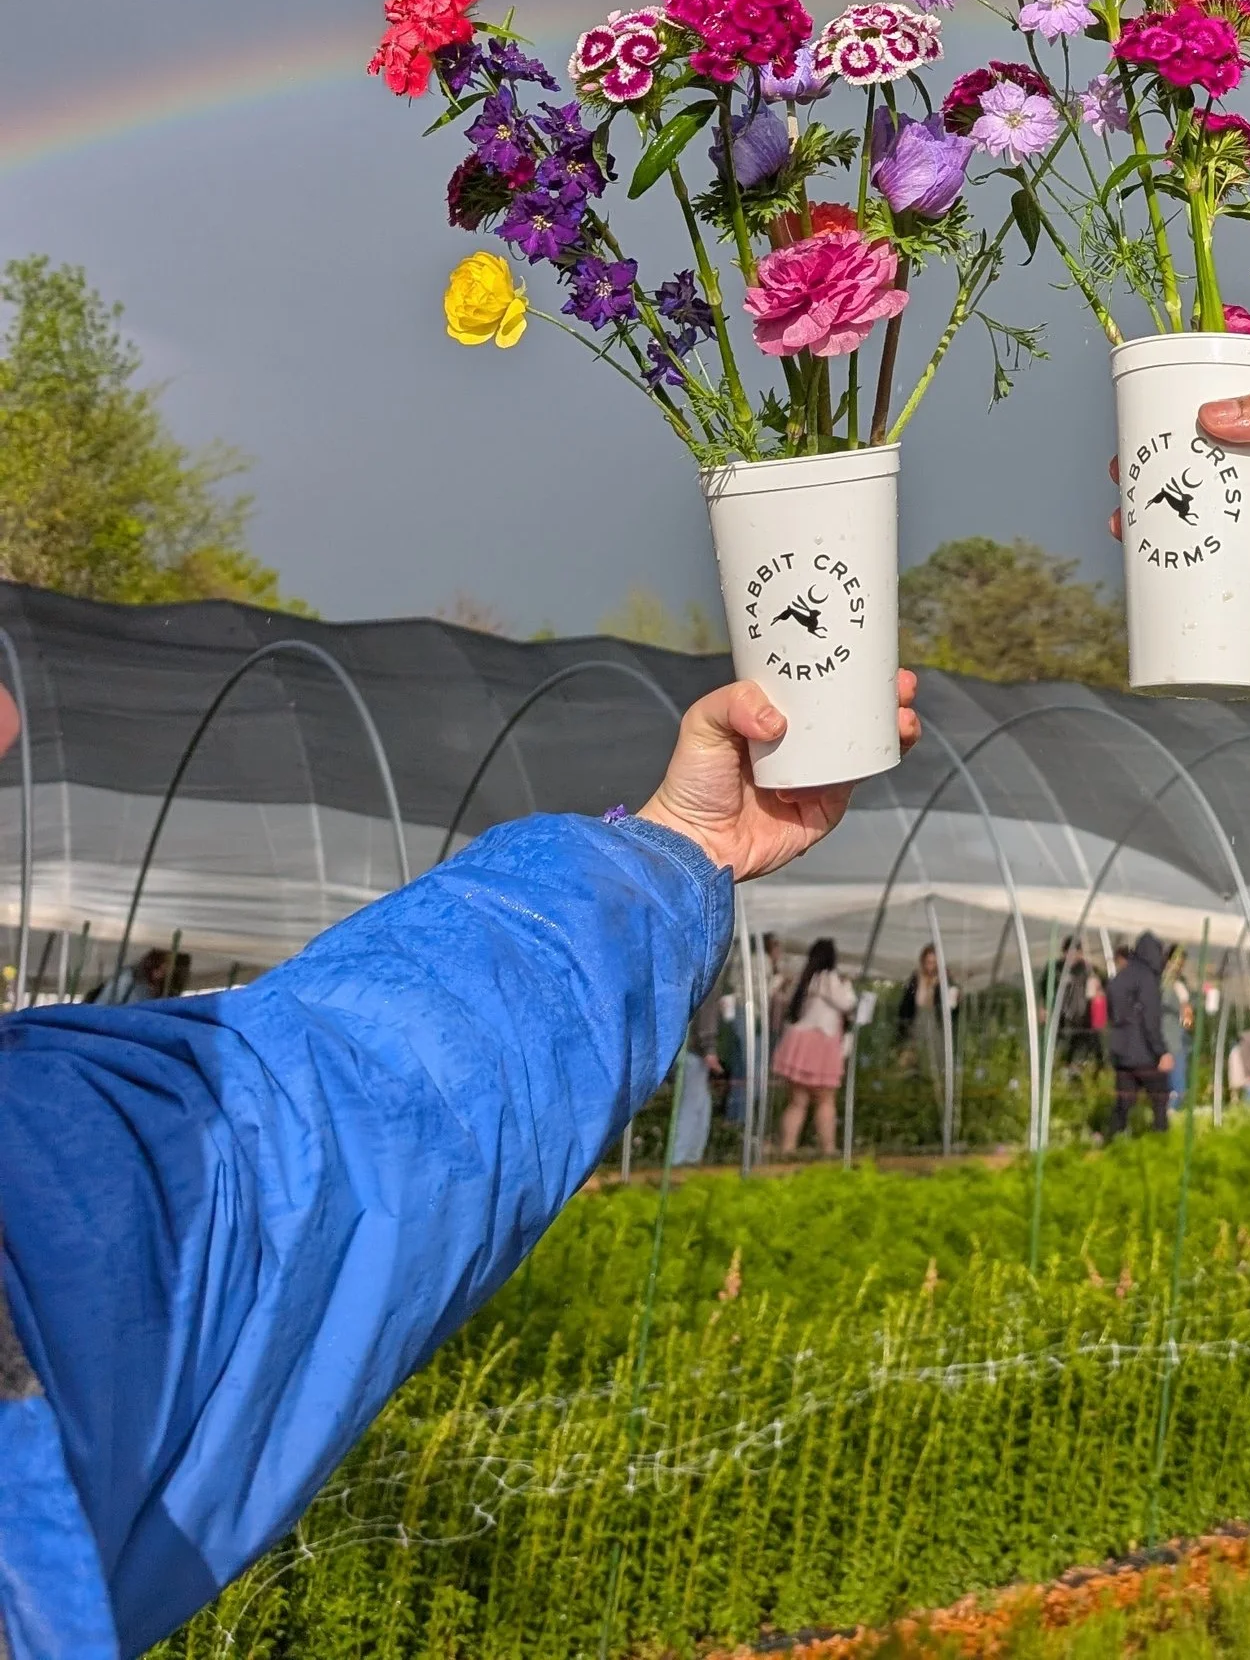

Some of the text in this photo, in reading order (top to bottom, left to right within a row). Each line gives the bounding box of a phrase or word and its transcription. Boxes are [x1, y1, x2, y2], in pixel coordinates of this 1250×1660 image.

[1126, 432, 1242, 527] RABBIT CREST
[1138, 535, 1221, 569] FARMS
[745, 552, 865, 640] RABBIT CREST
[766, 644, 851, 681] FARMS
